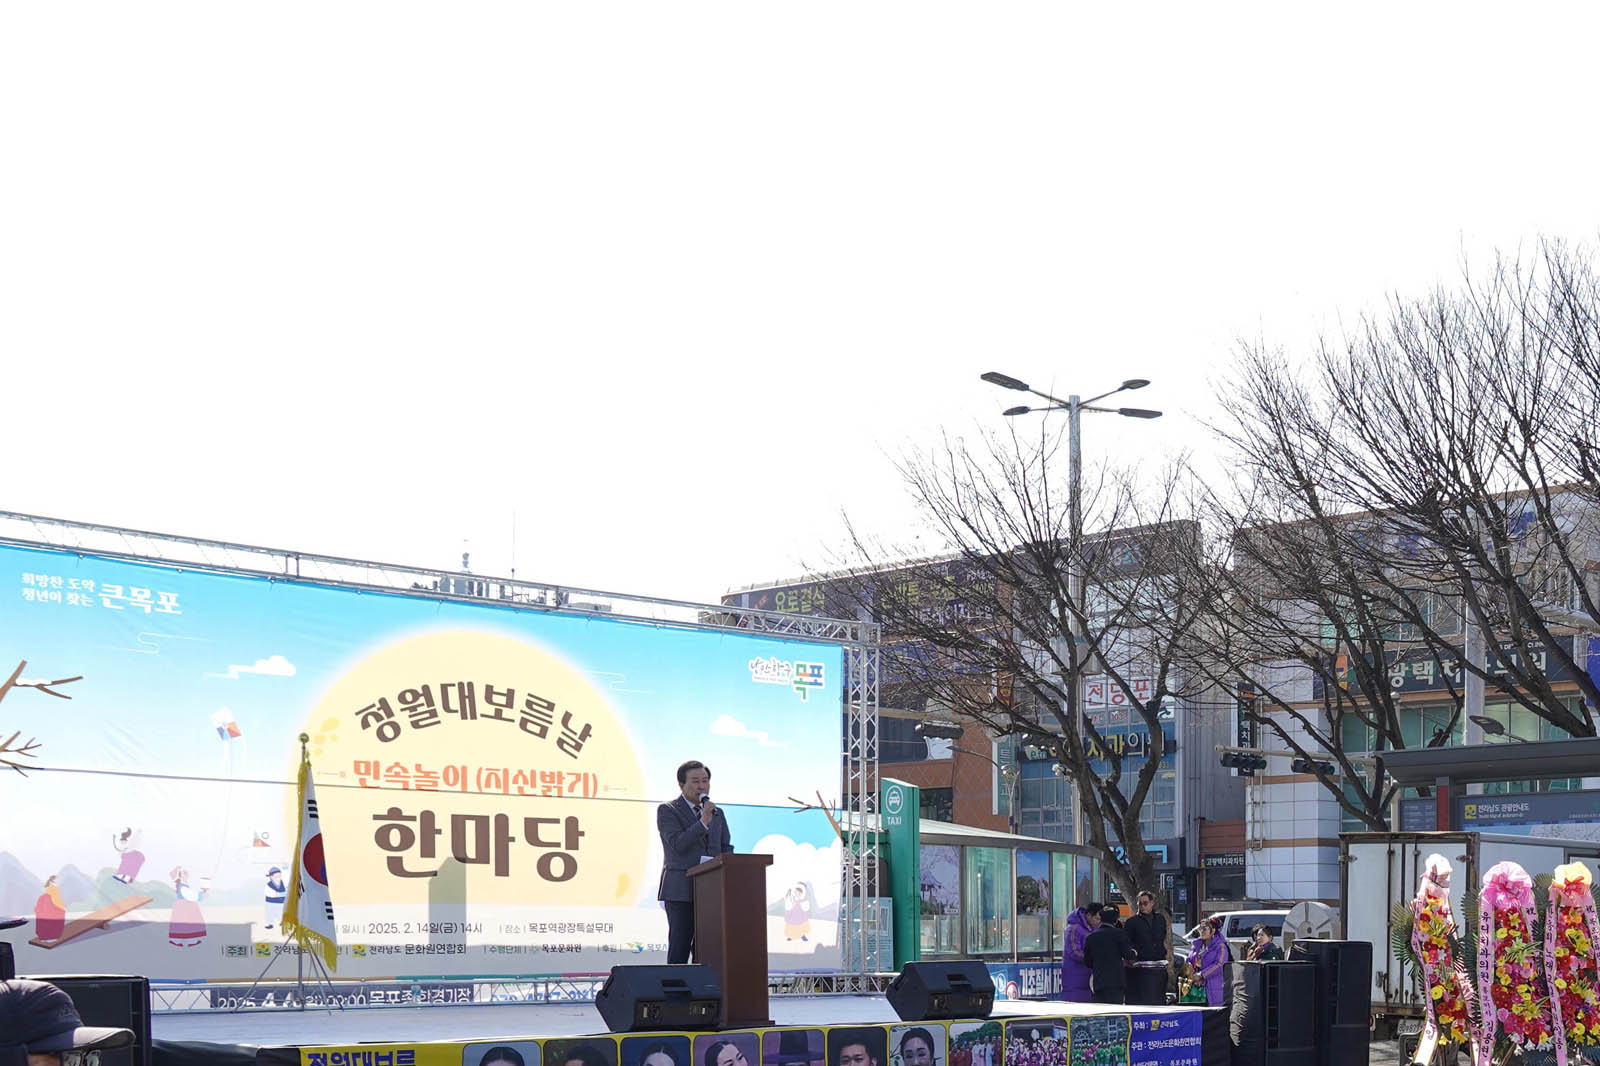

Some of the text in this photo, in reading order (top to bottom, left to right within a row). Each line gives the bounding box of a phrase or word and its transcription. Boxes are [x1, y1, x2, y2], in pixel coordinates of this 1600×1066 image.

[22, 573, 95, 592] 희망찬 도약
[22, 588, 94, 607] 청년이 찾는
[99, 583, 182, 614] 큰목포
[1087, 679, 1149, 707] 전당포
[355, 681, 592, 759] 정월대보름날
[353, 760, 599, 798] 민속놀이 (지신밝기)
[887, 816, 902, 825] TAXI
[372, 807, 585, 882] 한마당
[368, 922, 400, 934] 2025.
[460, 922, 483, 934] 14시
[528, 922, 614, 934] 목포역광장특설무대
[404, 943, 467, 955] 문화원연합회
